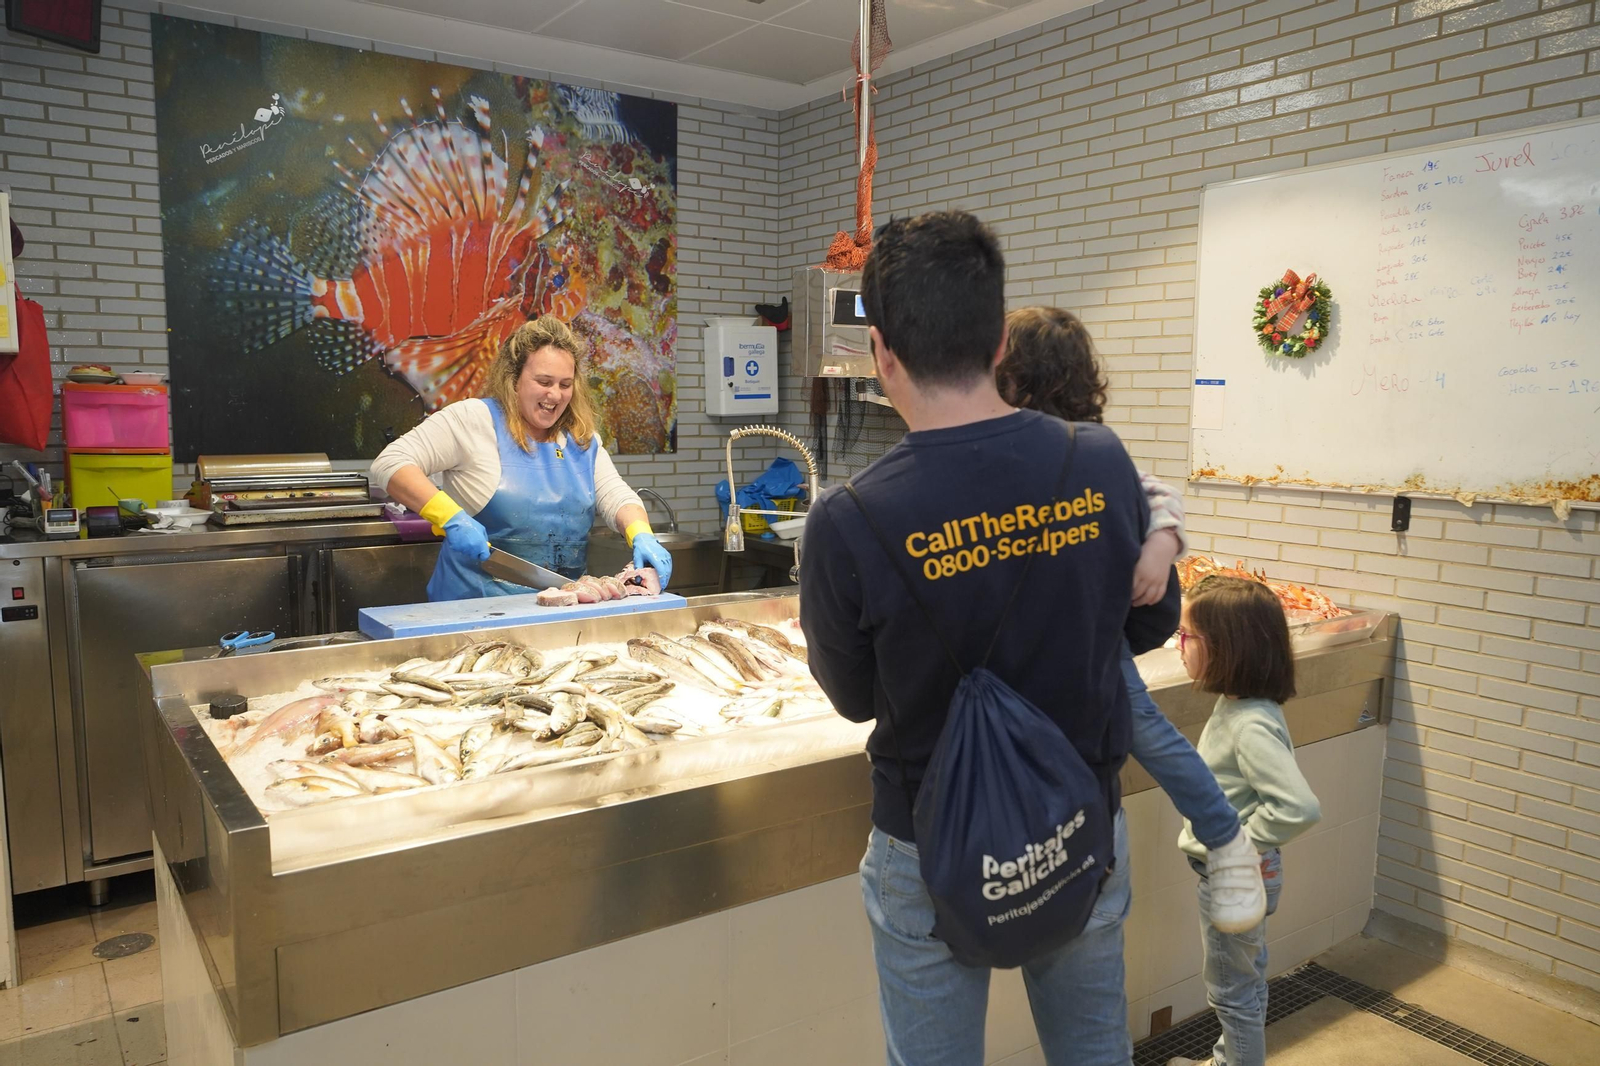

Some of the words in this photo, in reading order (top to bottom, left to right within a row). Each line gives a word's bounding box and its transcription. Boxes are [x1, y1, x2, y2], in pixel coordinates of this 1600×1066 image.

[206, 149, 233, 165] PESCADOS
[236, 137, 262, 151] MARISCOS
[1475, 142, 1535, 172] Jurel
[1447, 175, 1464, 184] 10€
[1415, 202, 1432, 213] 15€
[1559, 205, 1585, 219] 38€
[1407, 219, 1426, 230] 22€
[1410, 234, 1427, 246] 17€
[1555, 233, 1572, 242] 45€
[1412, 254, 1428, 264] 30€
[1551, 249, 1574, 259] 22€
[1555, 296, 1576, 305] 20€
[1549, 360, 1579, 370] 25€
[982, 809, 1086, 879] Peritajes
[981, 849, 1069, 901] Galicia
